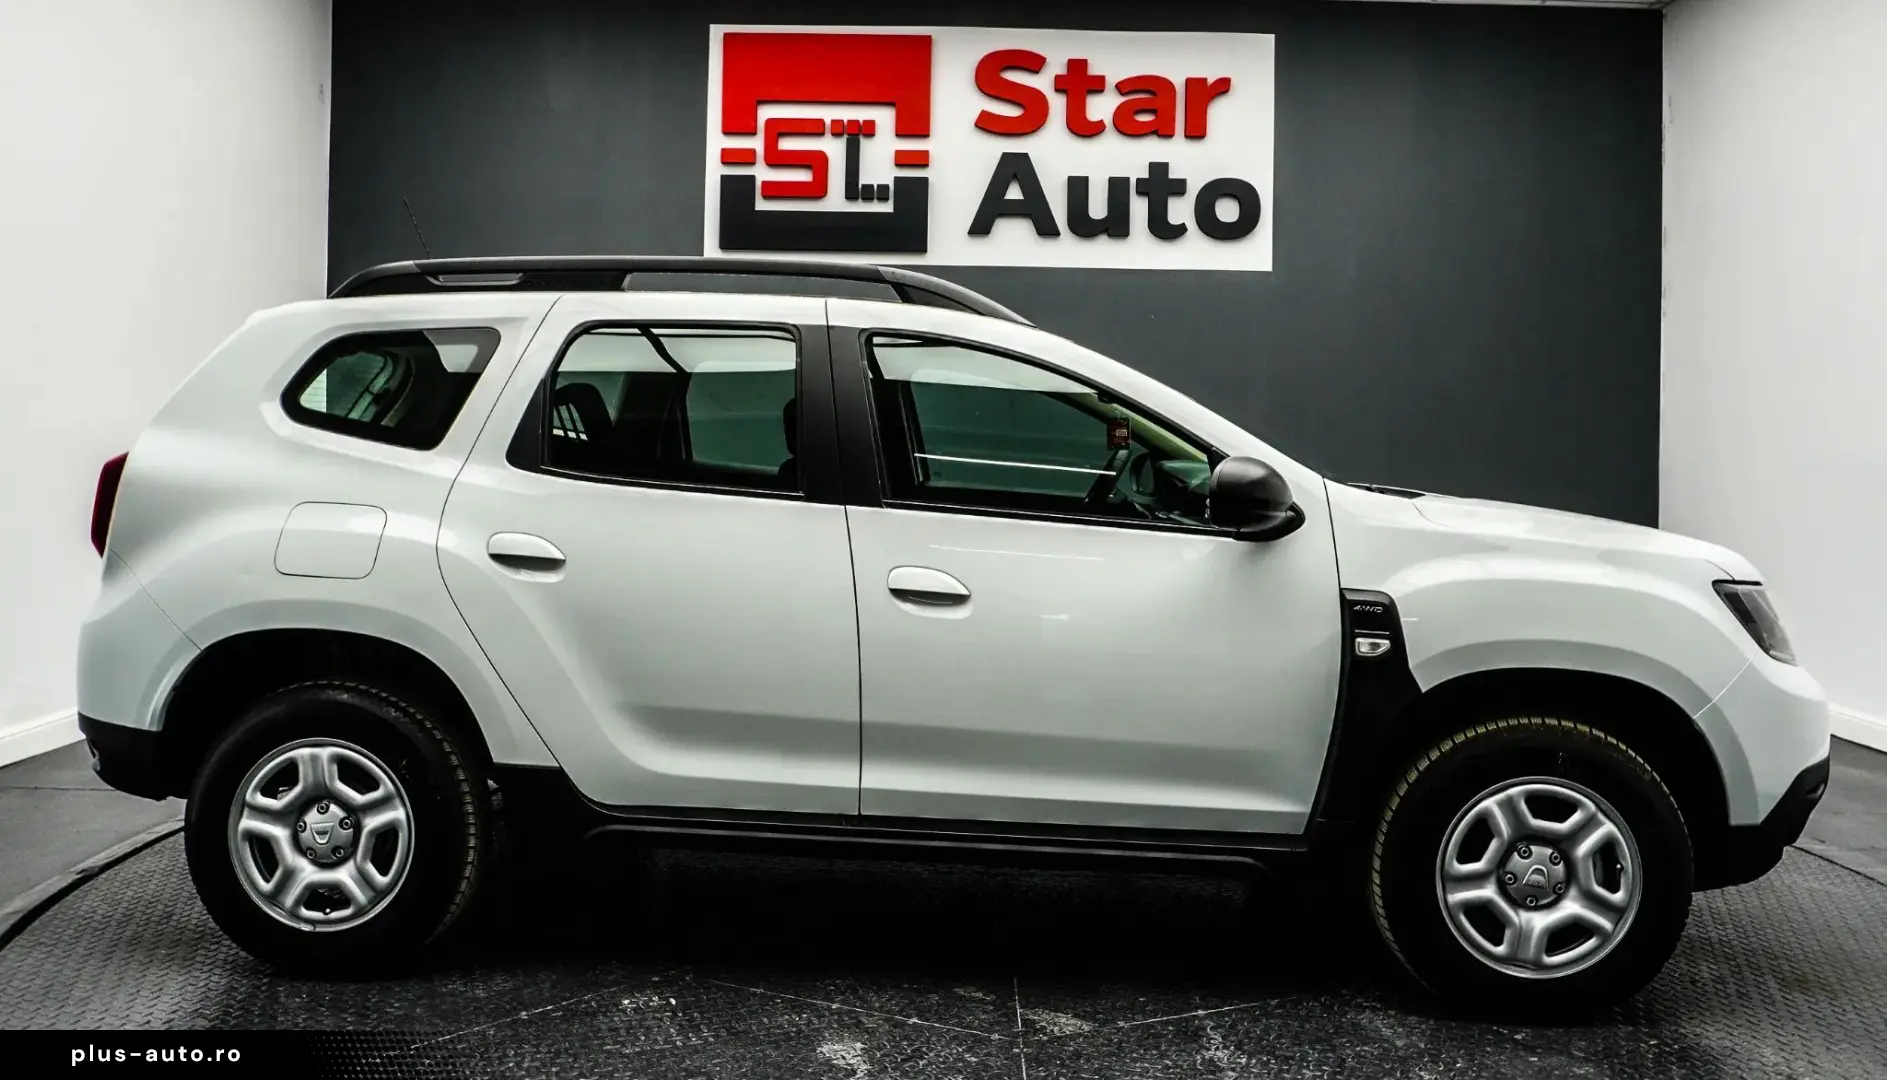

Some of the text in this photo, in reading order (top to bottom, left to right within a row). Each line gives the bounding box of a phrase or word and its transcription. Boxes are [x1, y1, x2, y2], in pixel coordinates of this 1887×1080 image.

[975, 49, 1231, 138] Star
[967, 152, 1261, 241] Auto
[1353, 605, 1384, 613] 4WD
